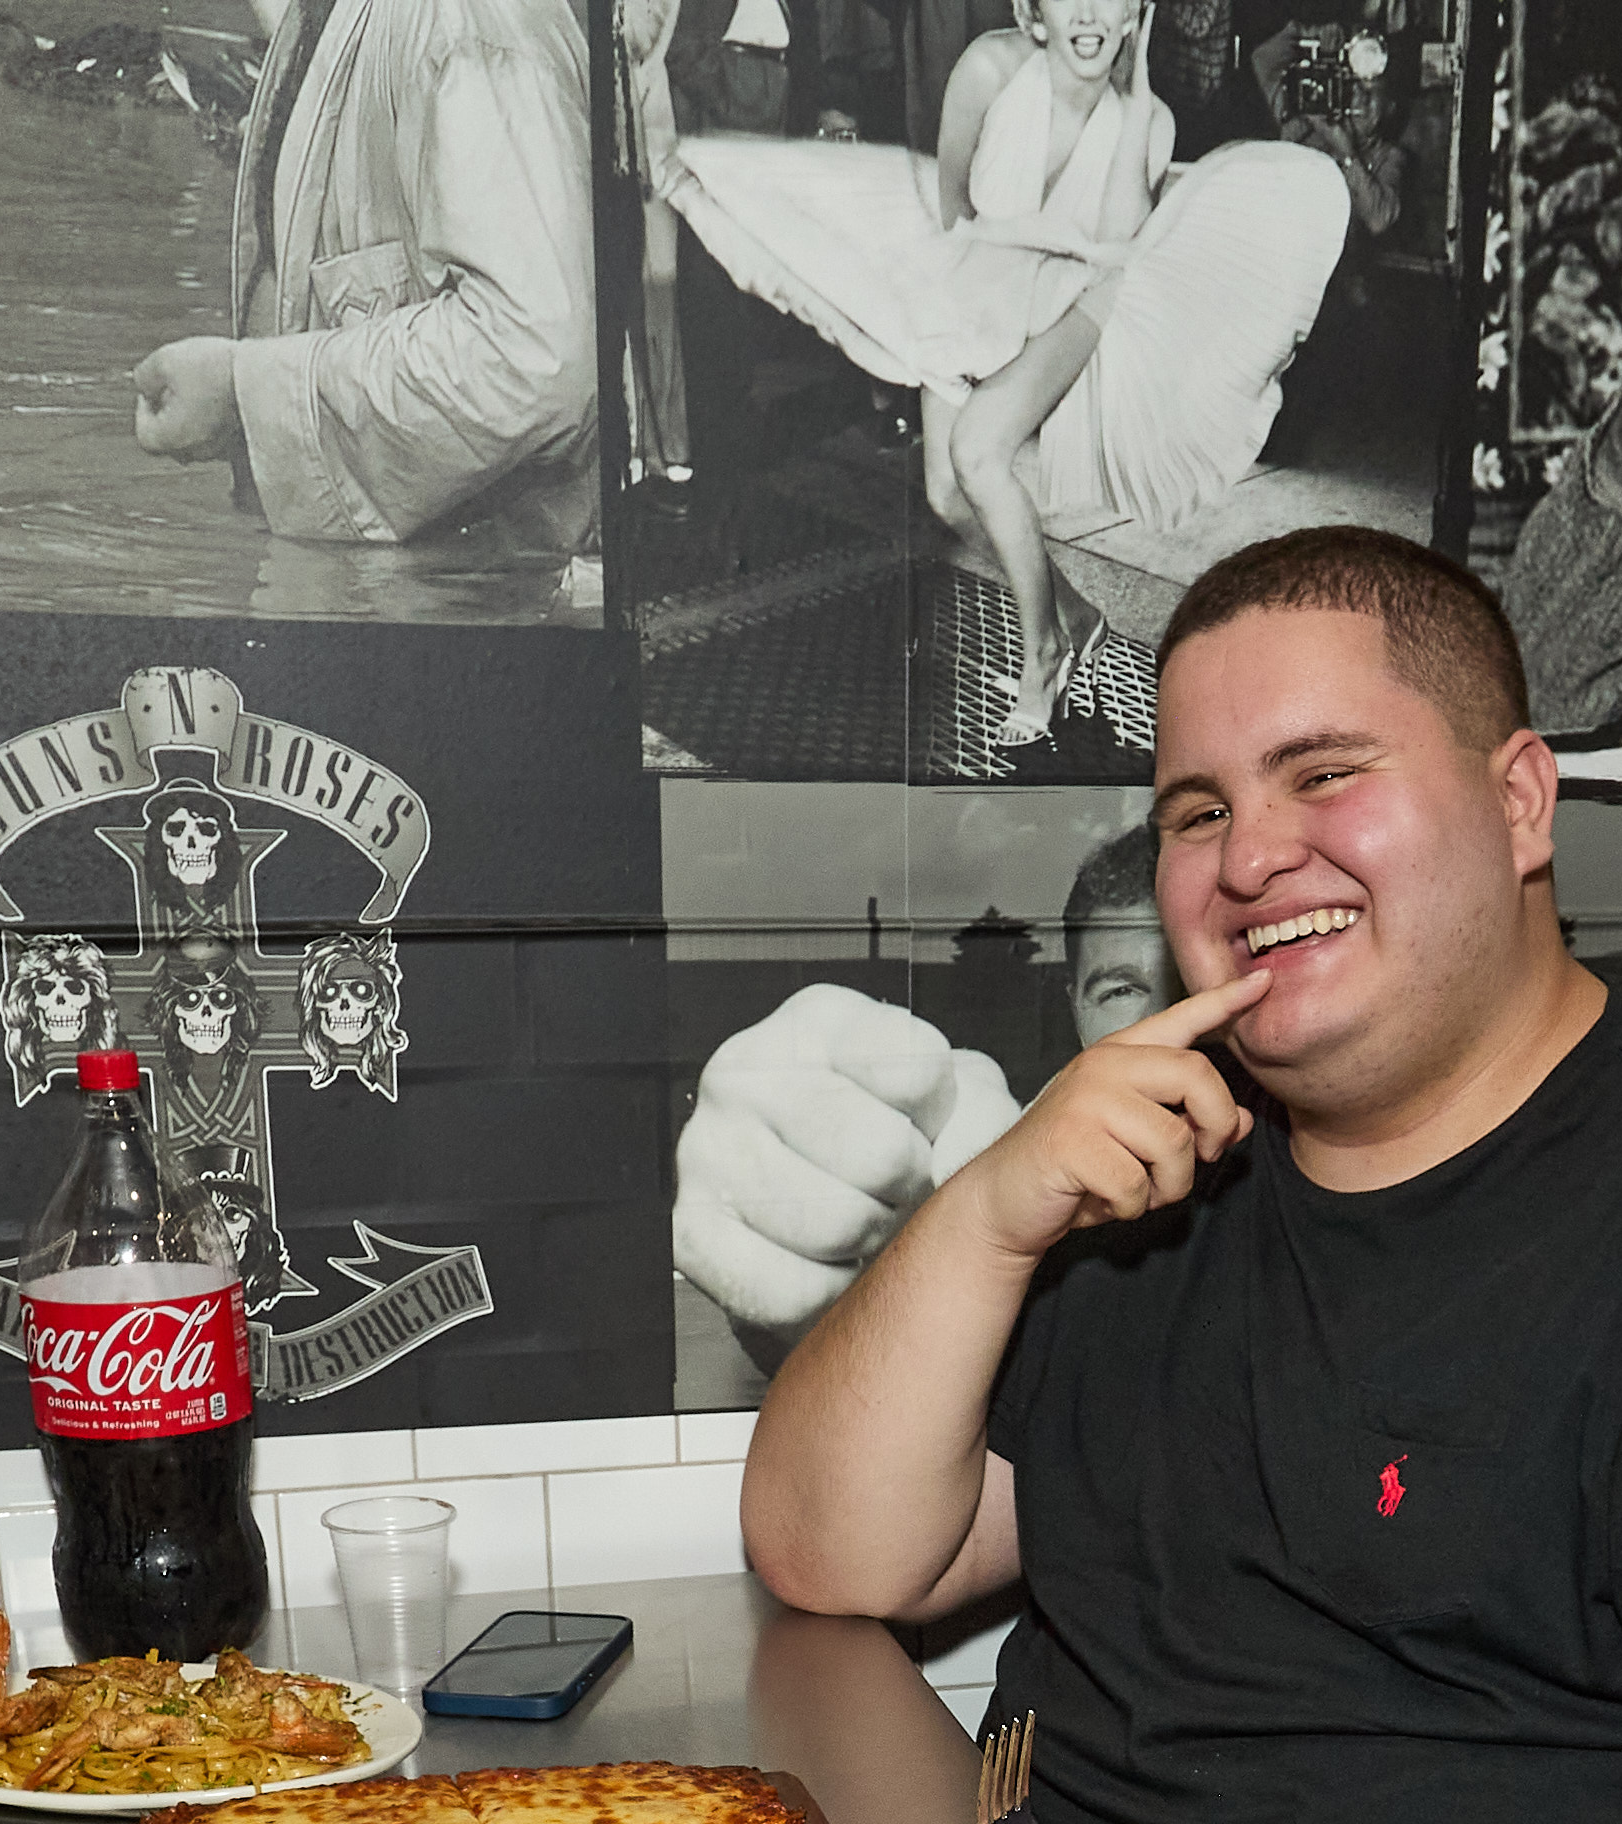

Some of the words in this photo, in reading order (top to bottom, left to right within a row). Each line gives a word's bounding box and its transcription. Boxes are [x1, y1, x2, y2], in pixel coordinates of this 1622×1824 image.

[242, 723, 414, 849] ROSES
[279, 1254, 485, 1389] DESTRUCTION
[47, 1396, 109, 1412] ORIGINAL
[112, 1398, 162, 1412] TASTE
[102, 1419, 160, 1430] Refreshing
